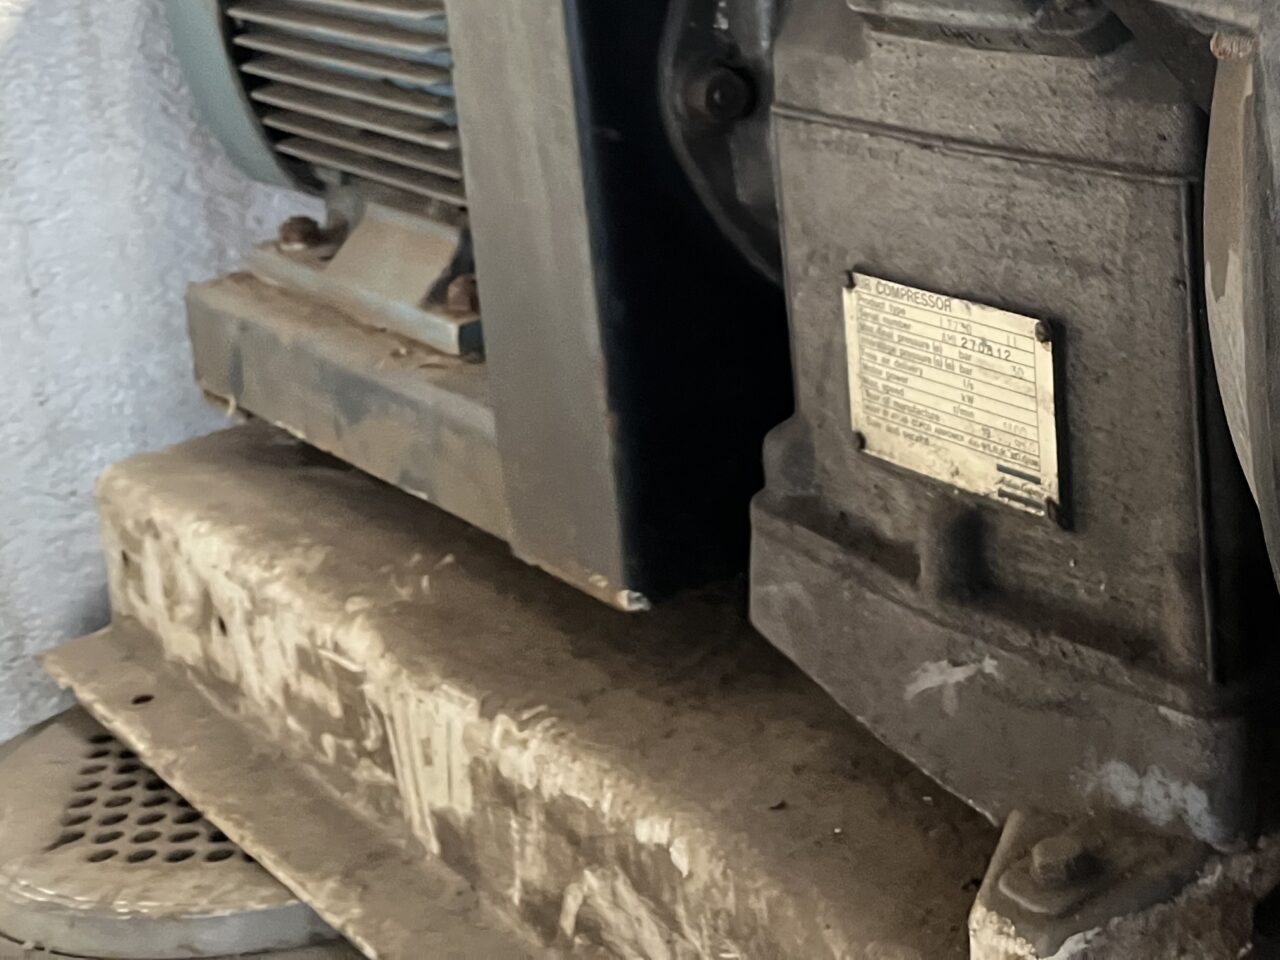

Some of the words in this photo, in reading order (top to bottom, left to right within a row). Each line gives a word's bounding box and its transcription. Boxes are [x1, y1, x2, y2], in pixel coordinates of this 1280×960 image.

[876, 280, 952, 312] COMPRESSOR
[883, 316, 911, 330] number
[958, 350, 972, 361] bar
[959, 362, 973, 375] bar
[961, 393, 974, 404] kW
